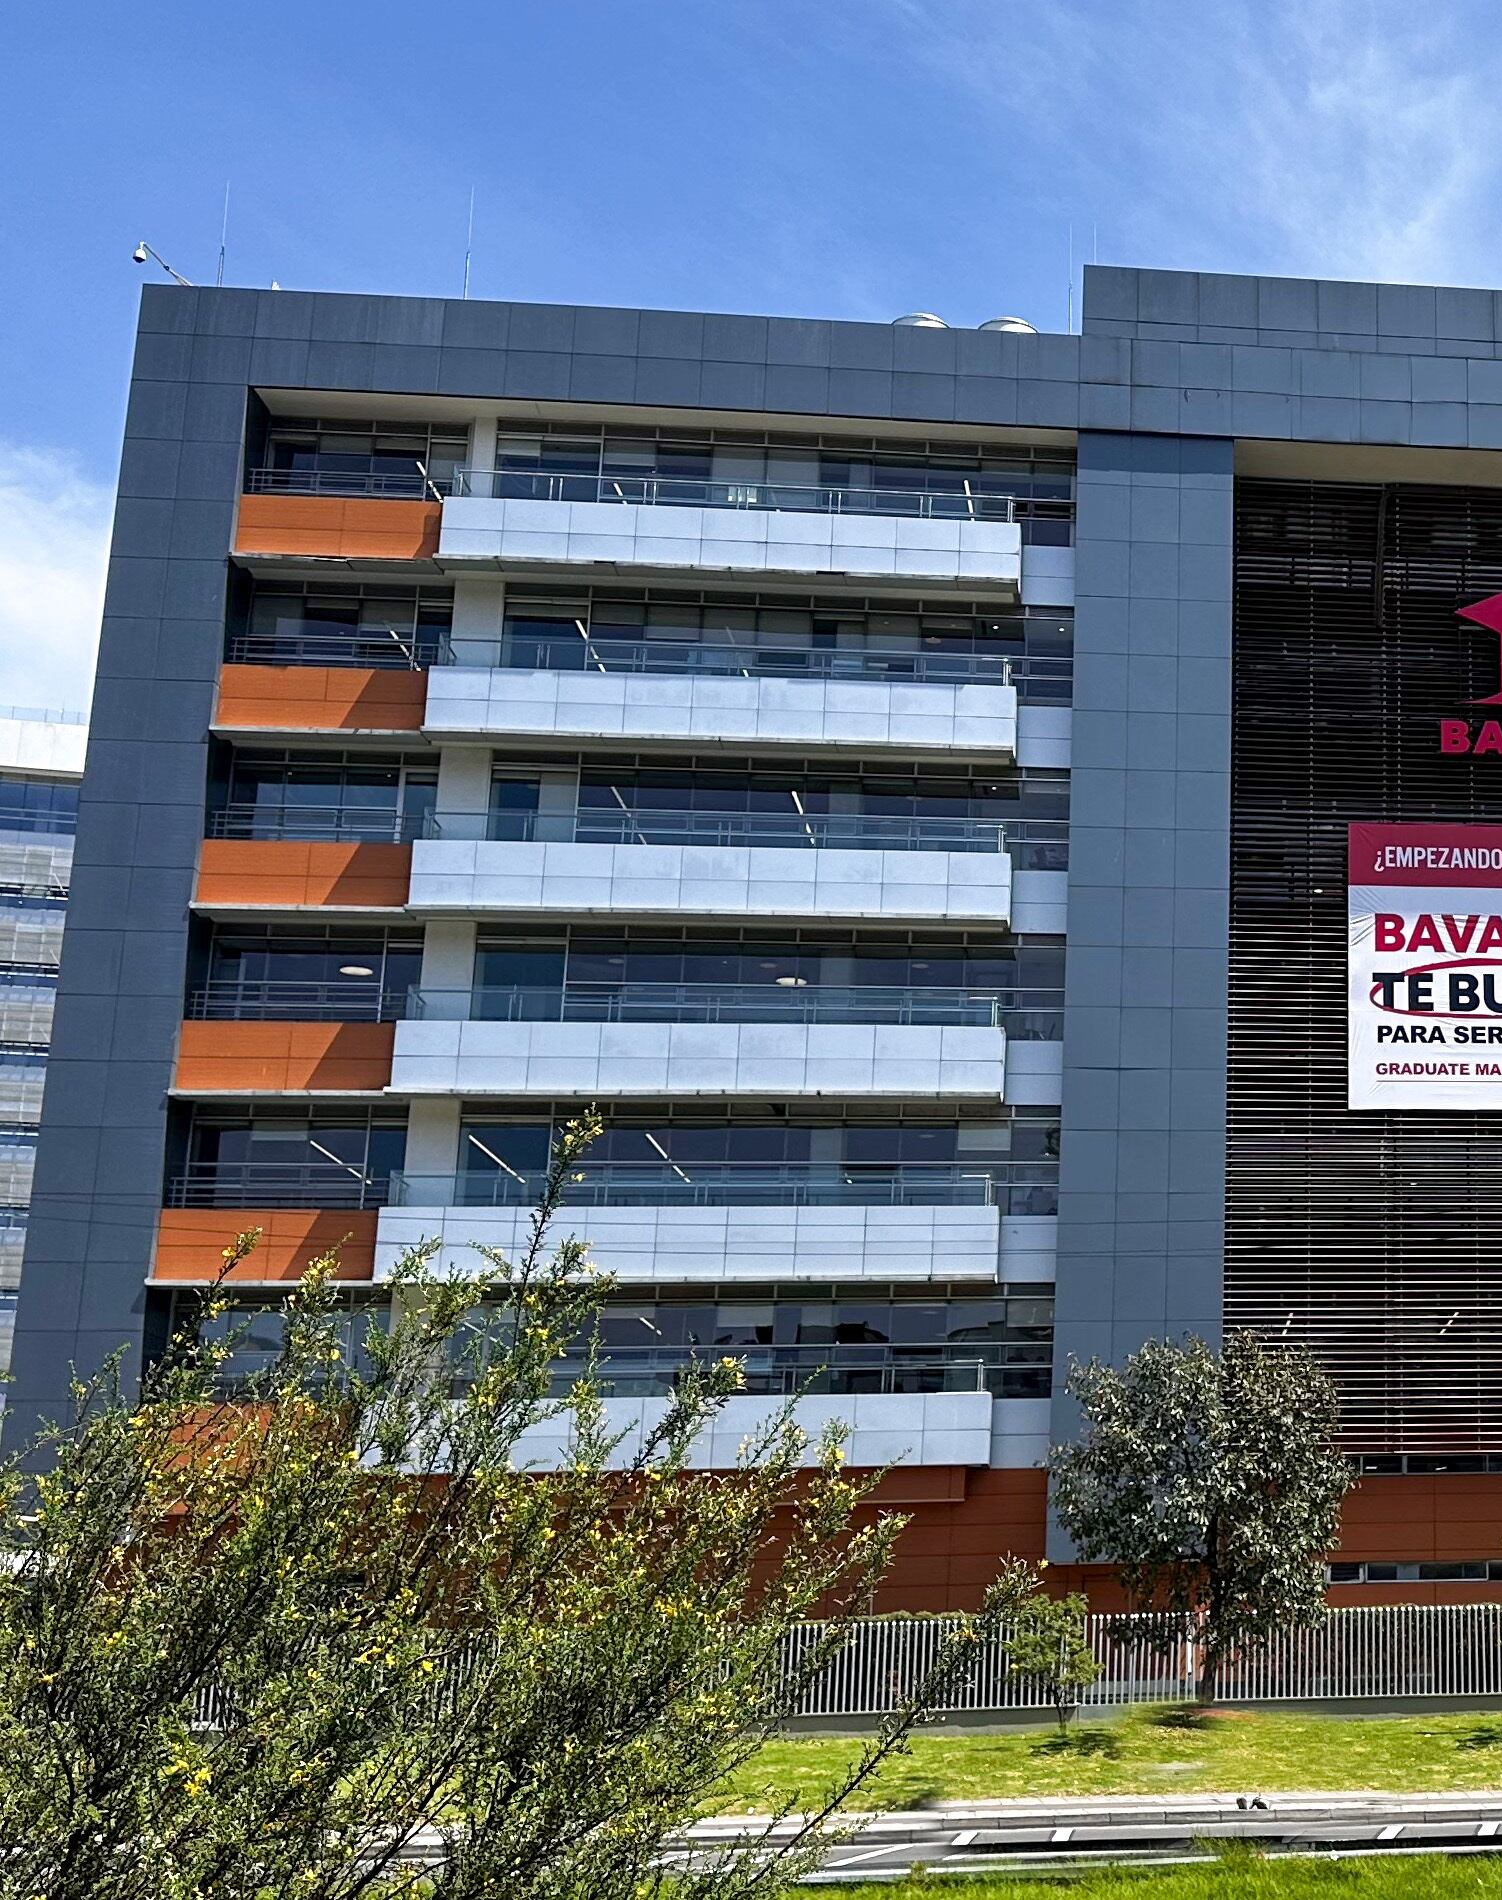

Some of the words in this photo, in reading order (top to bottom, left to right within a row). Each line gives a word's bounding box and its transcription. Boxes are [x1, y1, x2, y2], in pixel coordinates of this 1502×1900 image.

[1374, 846, 1502, 872] ¿EMPEZANDO
[1372, 972, 1434, 1011] TE
[1377, 1025, 1446, 1043] PARA
[1375, 1062, 1470, 1076] GRADUATE
